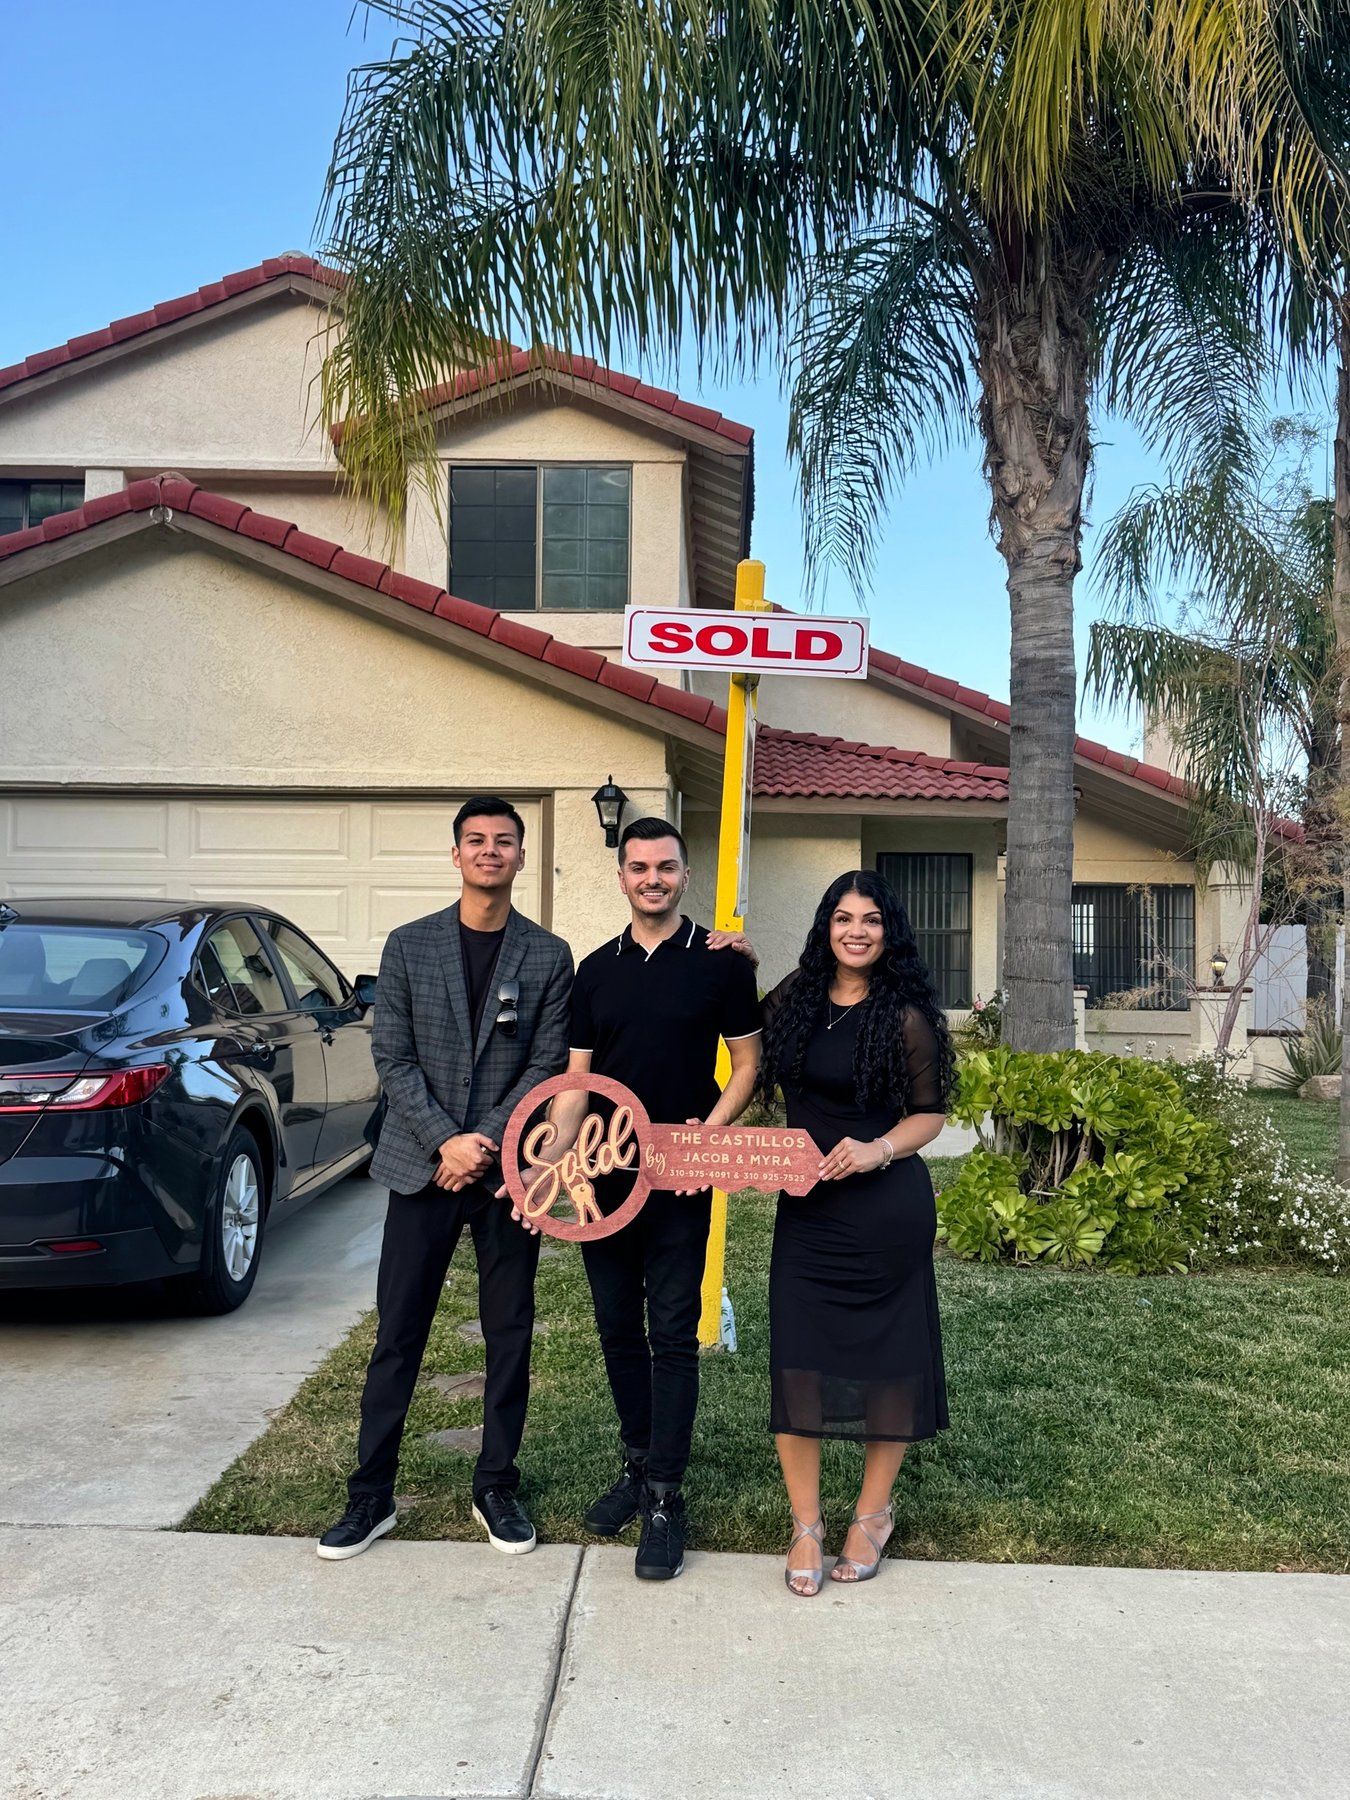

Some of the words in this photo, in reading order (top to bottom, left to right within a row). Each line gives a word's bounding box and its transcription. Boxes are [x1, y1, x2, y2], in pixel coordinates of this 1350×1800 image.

[647, 622, 843, 661] SOLD
[670, 1131, 702, 1145] THE
[709, 1133, 806, 1149] CASTILLOS
[524, 1105, 637, 1217] Sold
[645, 1143, 668, 1176] by
[682, 1152, 730, 1165] JACOB
[735, 1154, 744, 1165] &
[750, 1154, 792, 1167] MYRA
[733, 1171, 740, 1180] &
